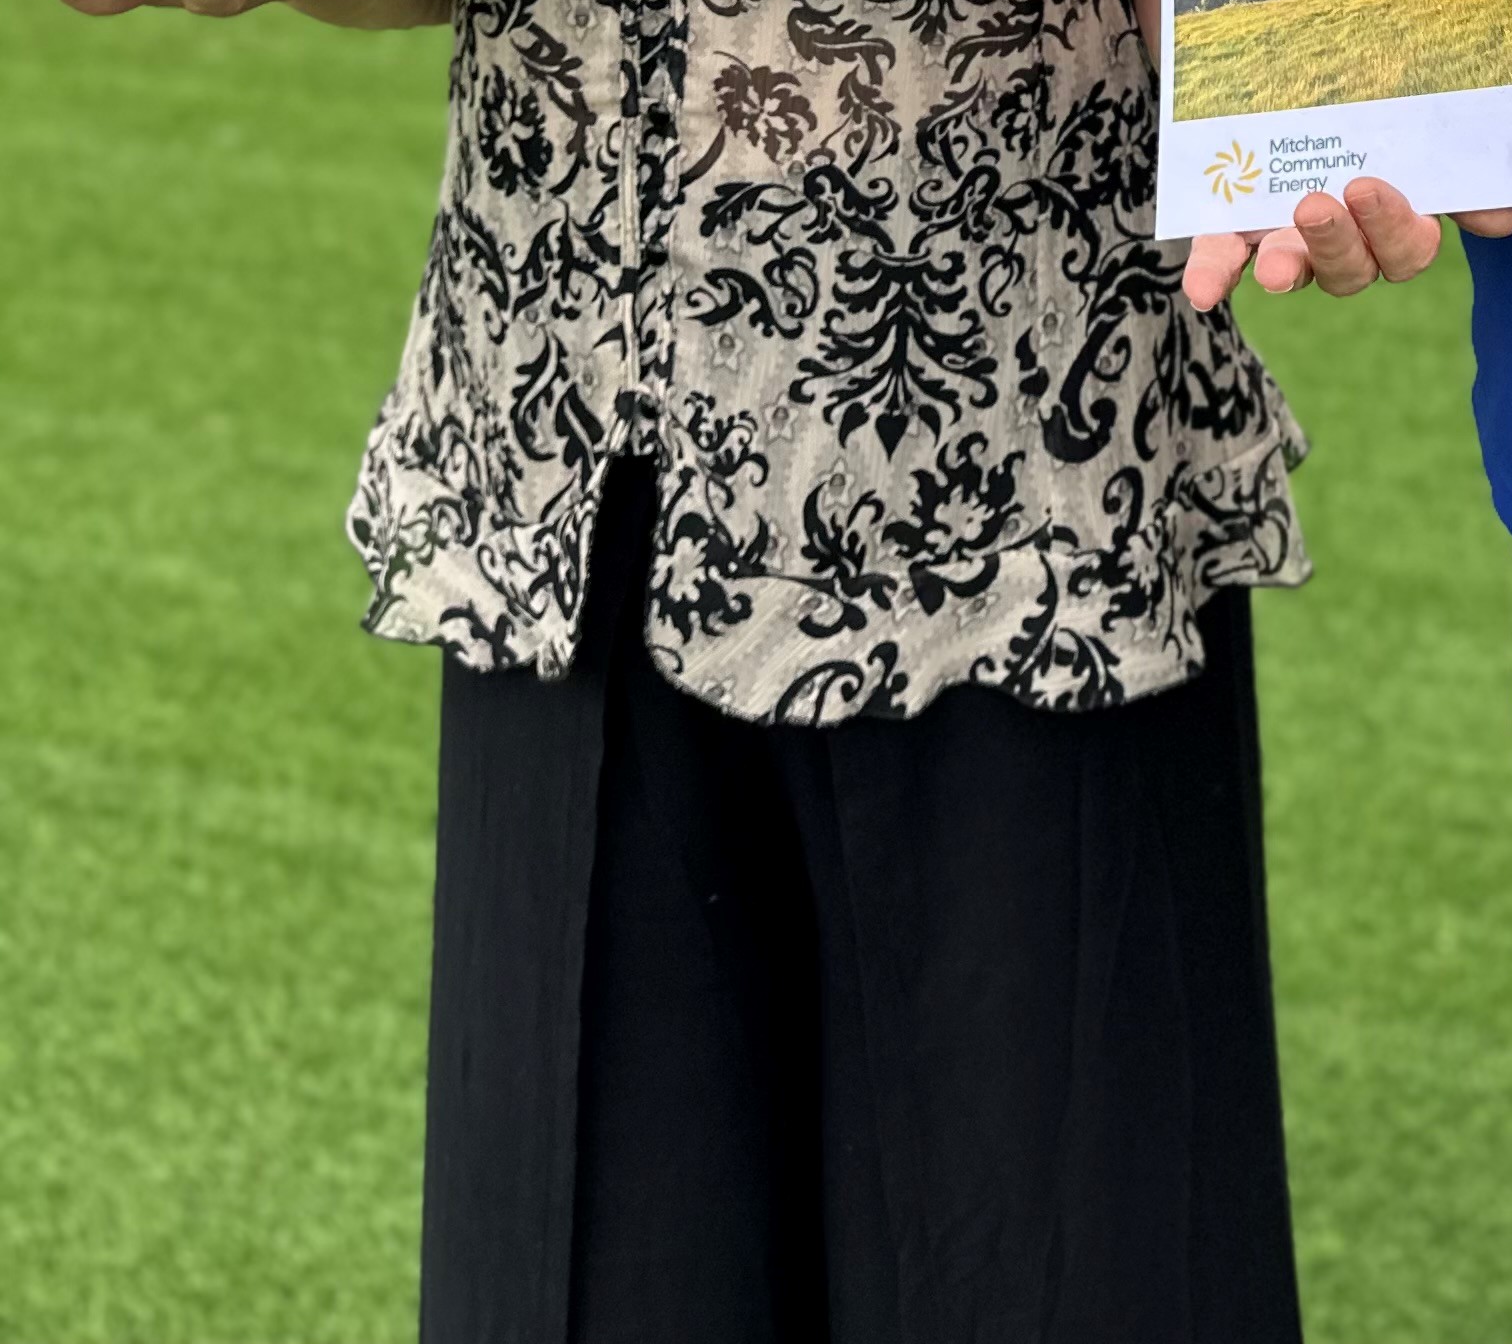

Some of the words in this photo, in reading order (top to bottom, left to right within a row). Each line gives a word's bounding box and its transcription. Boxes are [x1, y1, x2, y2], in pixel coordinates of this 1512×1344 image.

[1269, 134, 1342, 155] Mitcham
[1269, 149, 1368, 174] Community
[1269, 176, 1328, 193] Energy
